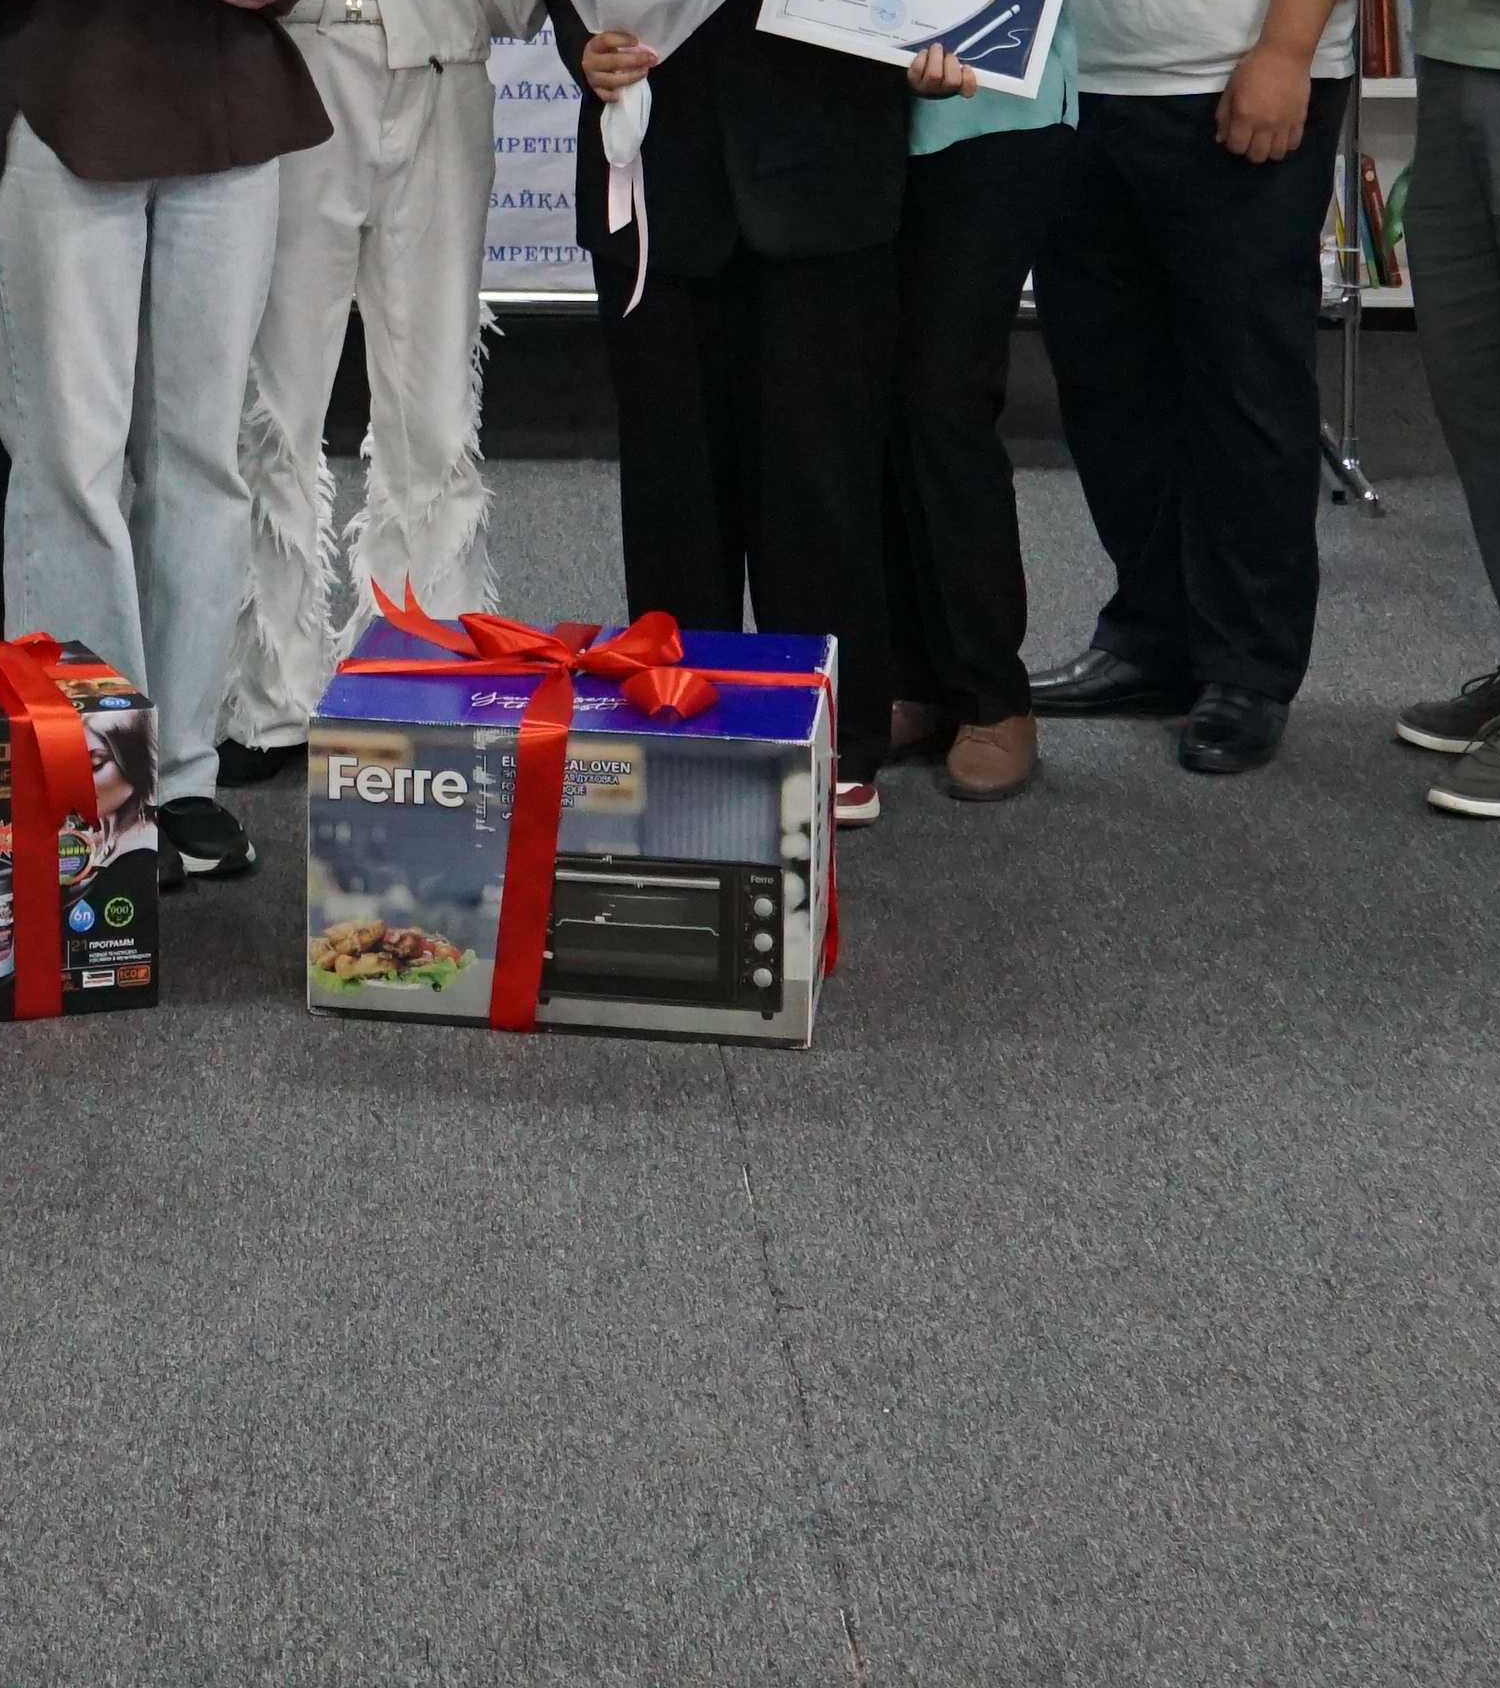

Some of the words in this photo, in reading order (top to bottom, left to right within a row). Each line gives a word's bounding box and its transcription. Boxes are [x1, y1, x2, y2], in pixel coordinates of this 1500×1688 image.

[498, 83, 583, 102] АЙҚАУ
[493, 137, 577, 154] MPETIT
[489, 192, 576, 211] БАЙҚА
[593, 760, 631, 775] OVEN
[328, 755, 469, 808] Ferre
